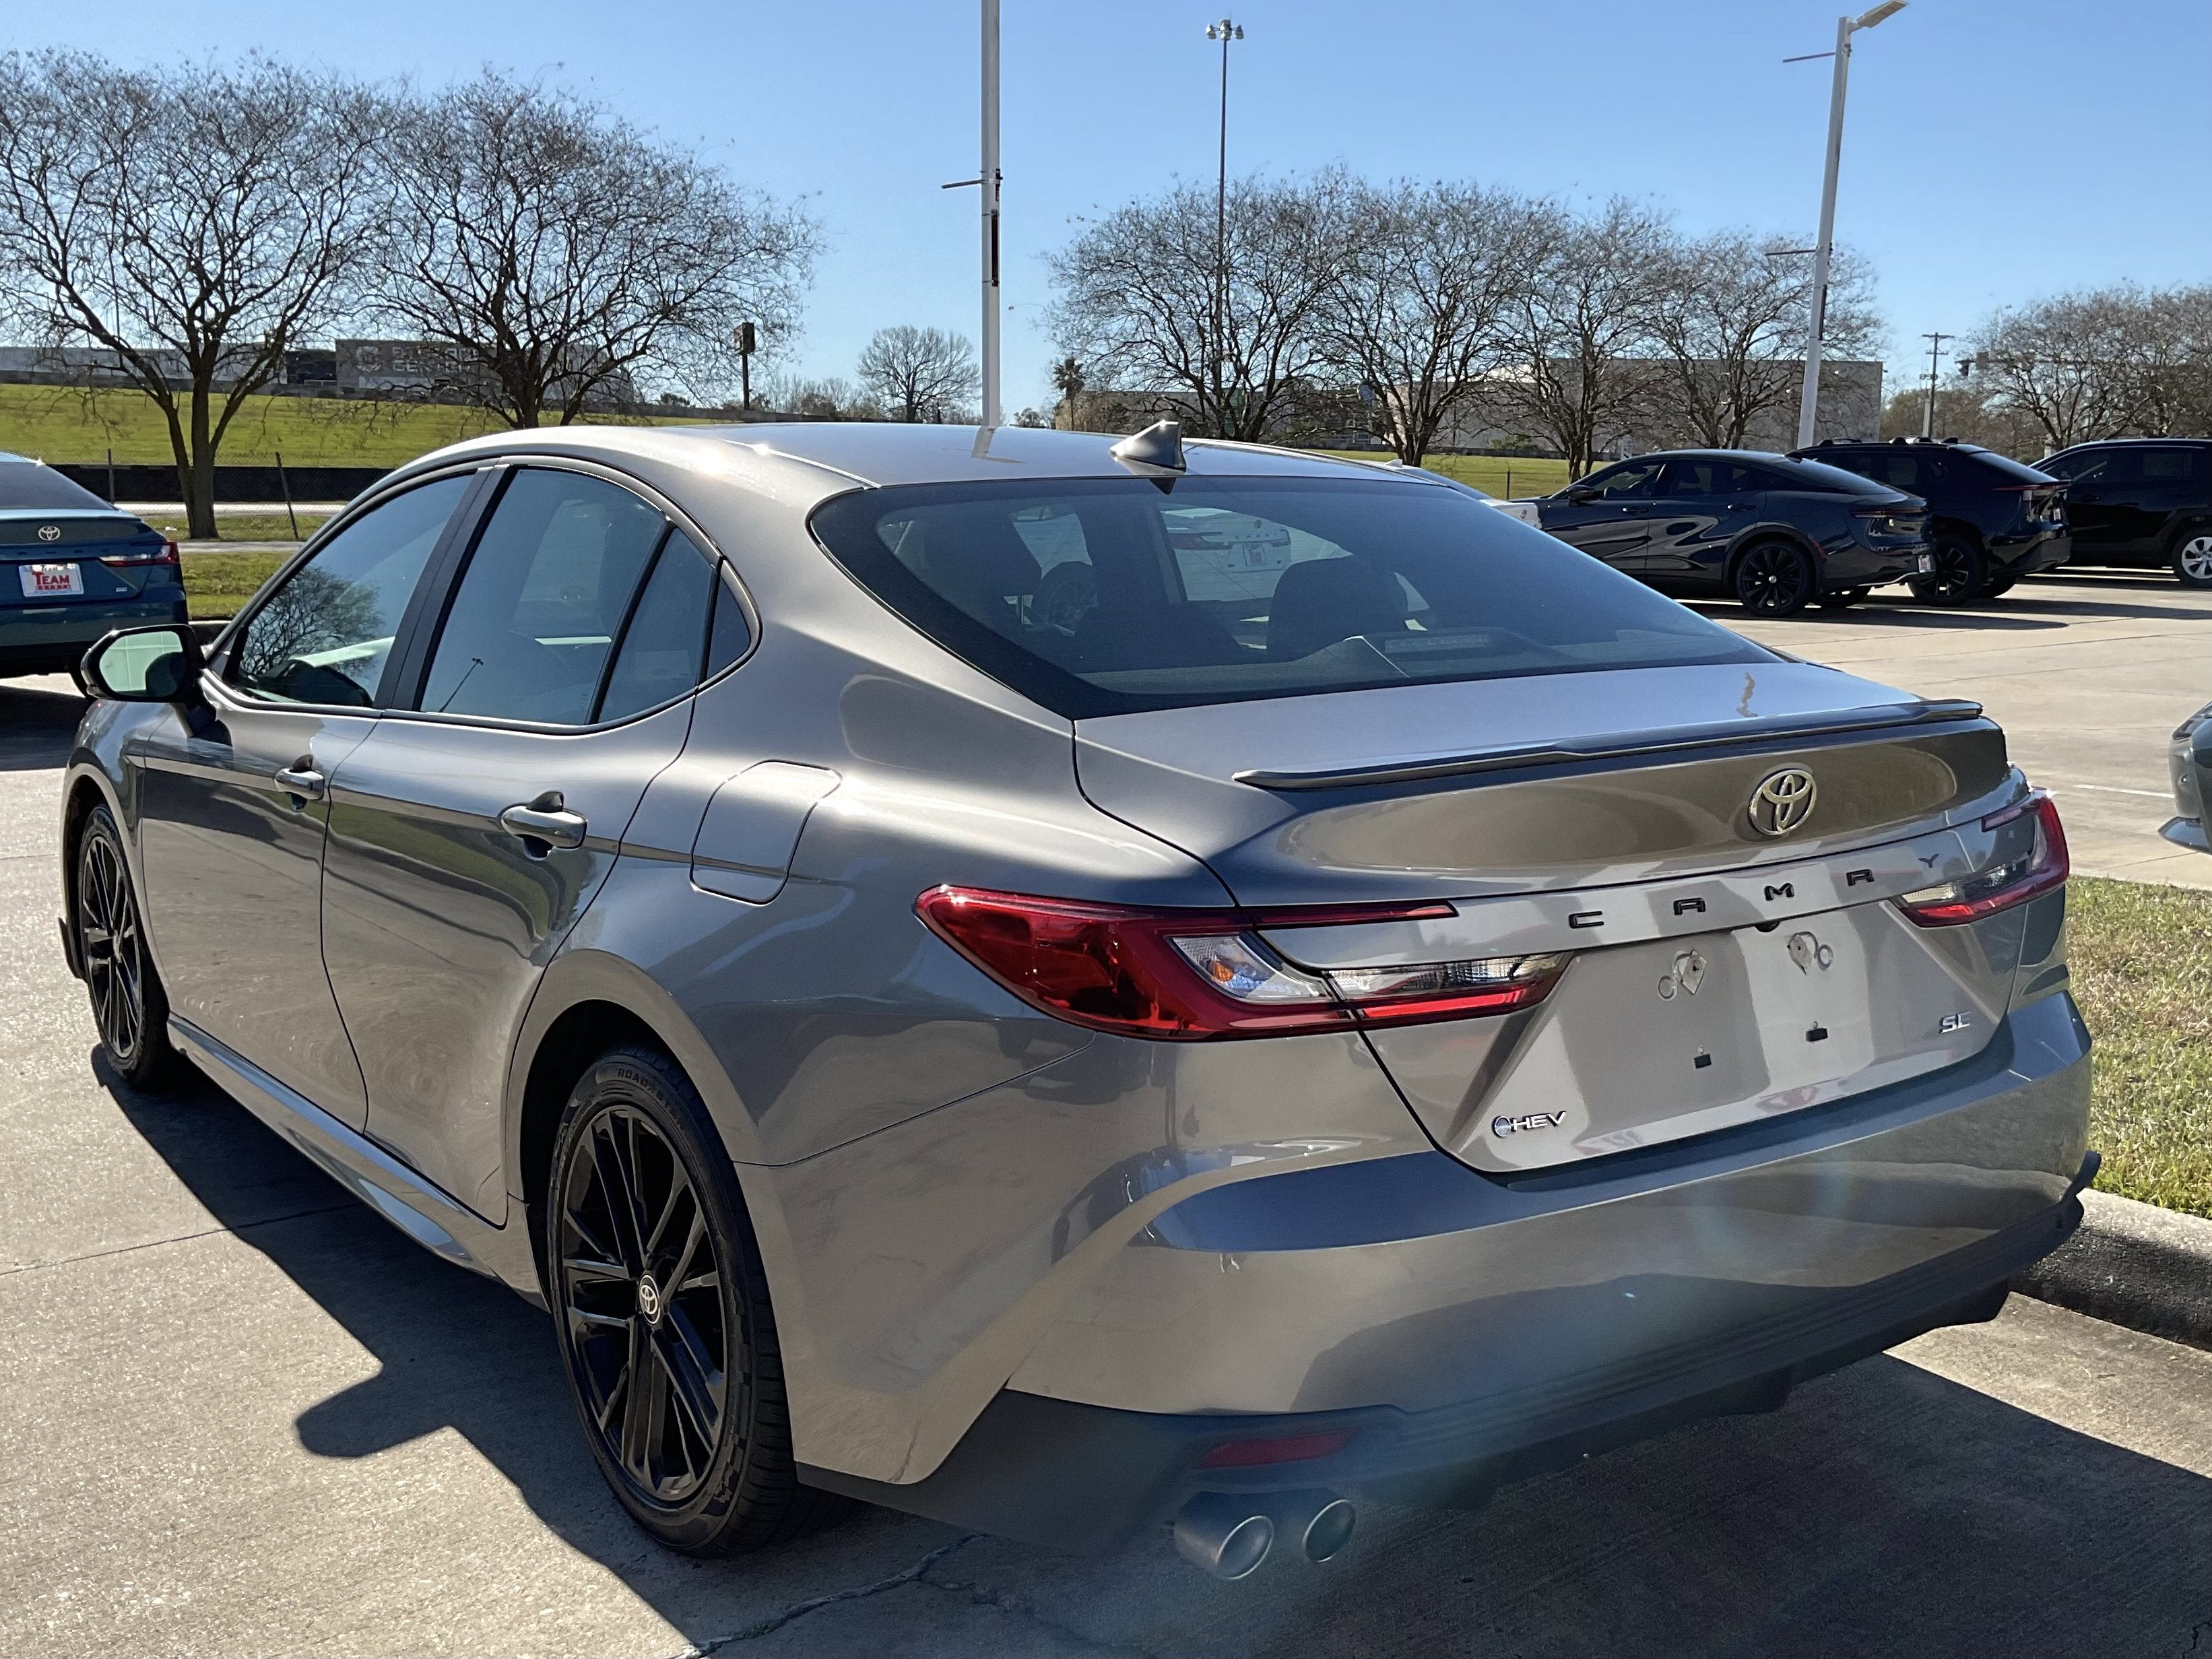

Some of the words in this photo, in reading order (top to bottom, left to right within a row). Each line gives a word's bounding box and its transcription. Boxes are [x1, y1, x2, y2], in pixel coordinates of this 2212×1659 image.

[32, 571, 69, 585] TEAM
[1568, 853, 1940, 929] CAMRY
[1939, 1011, 1971, 1034] SE
